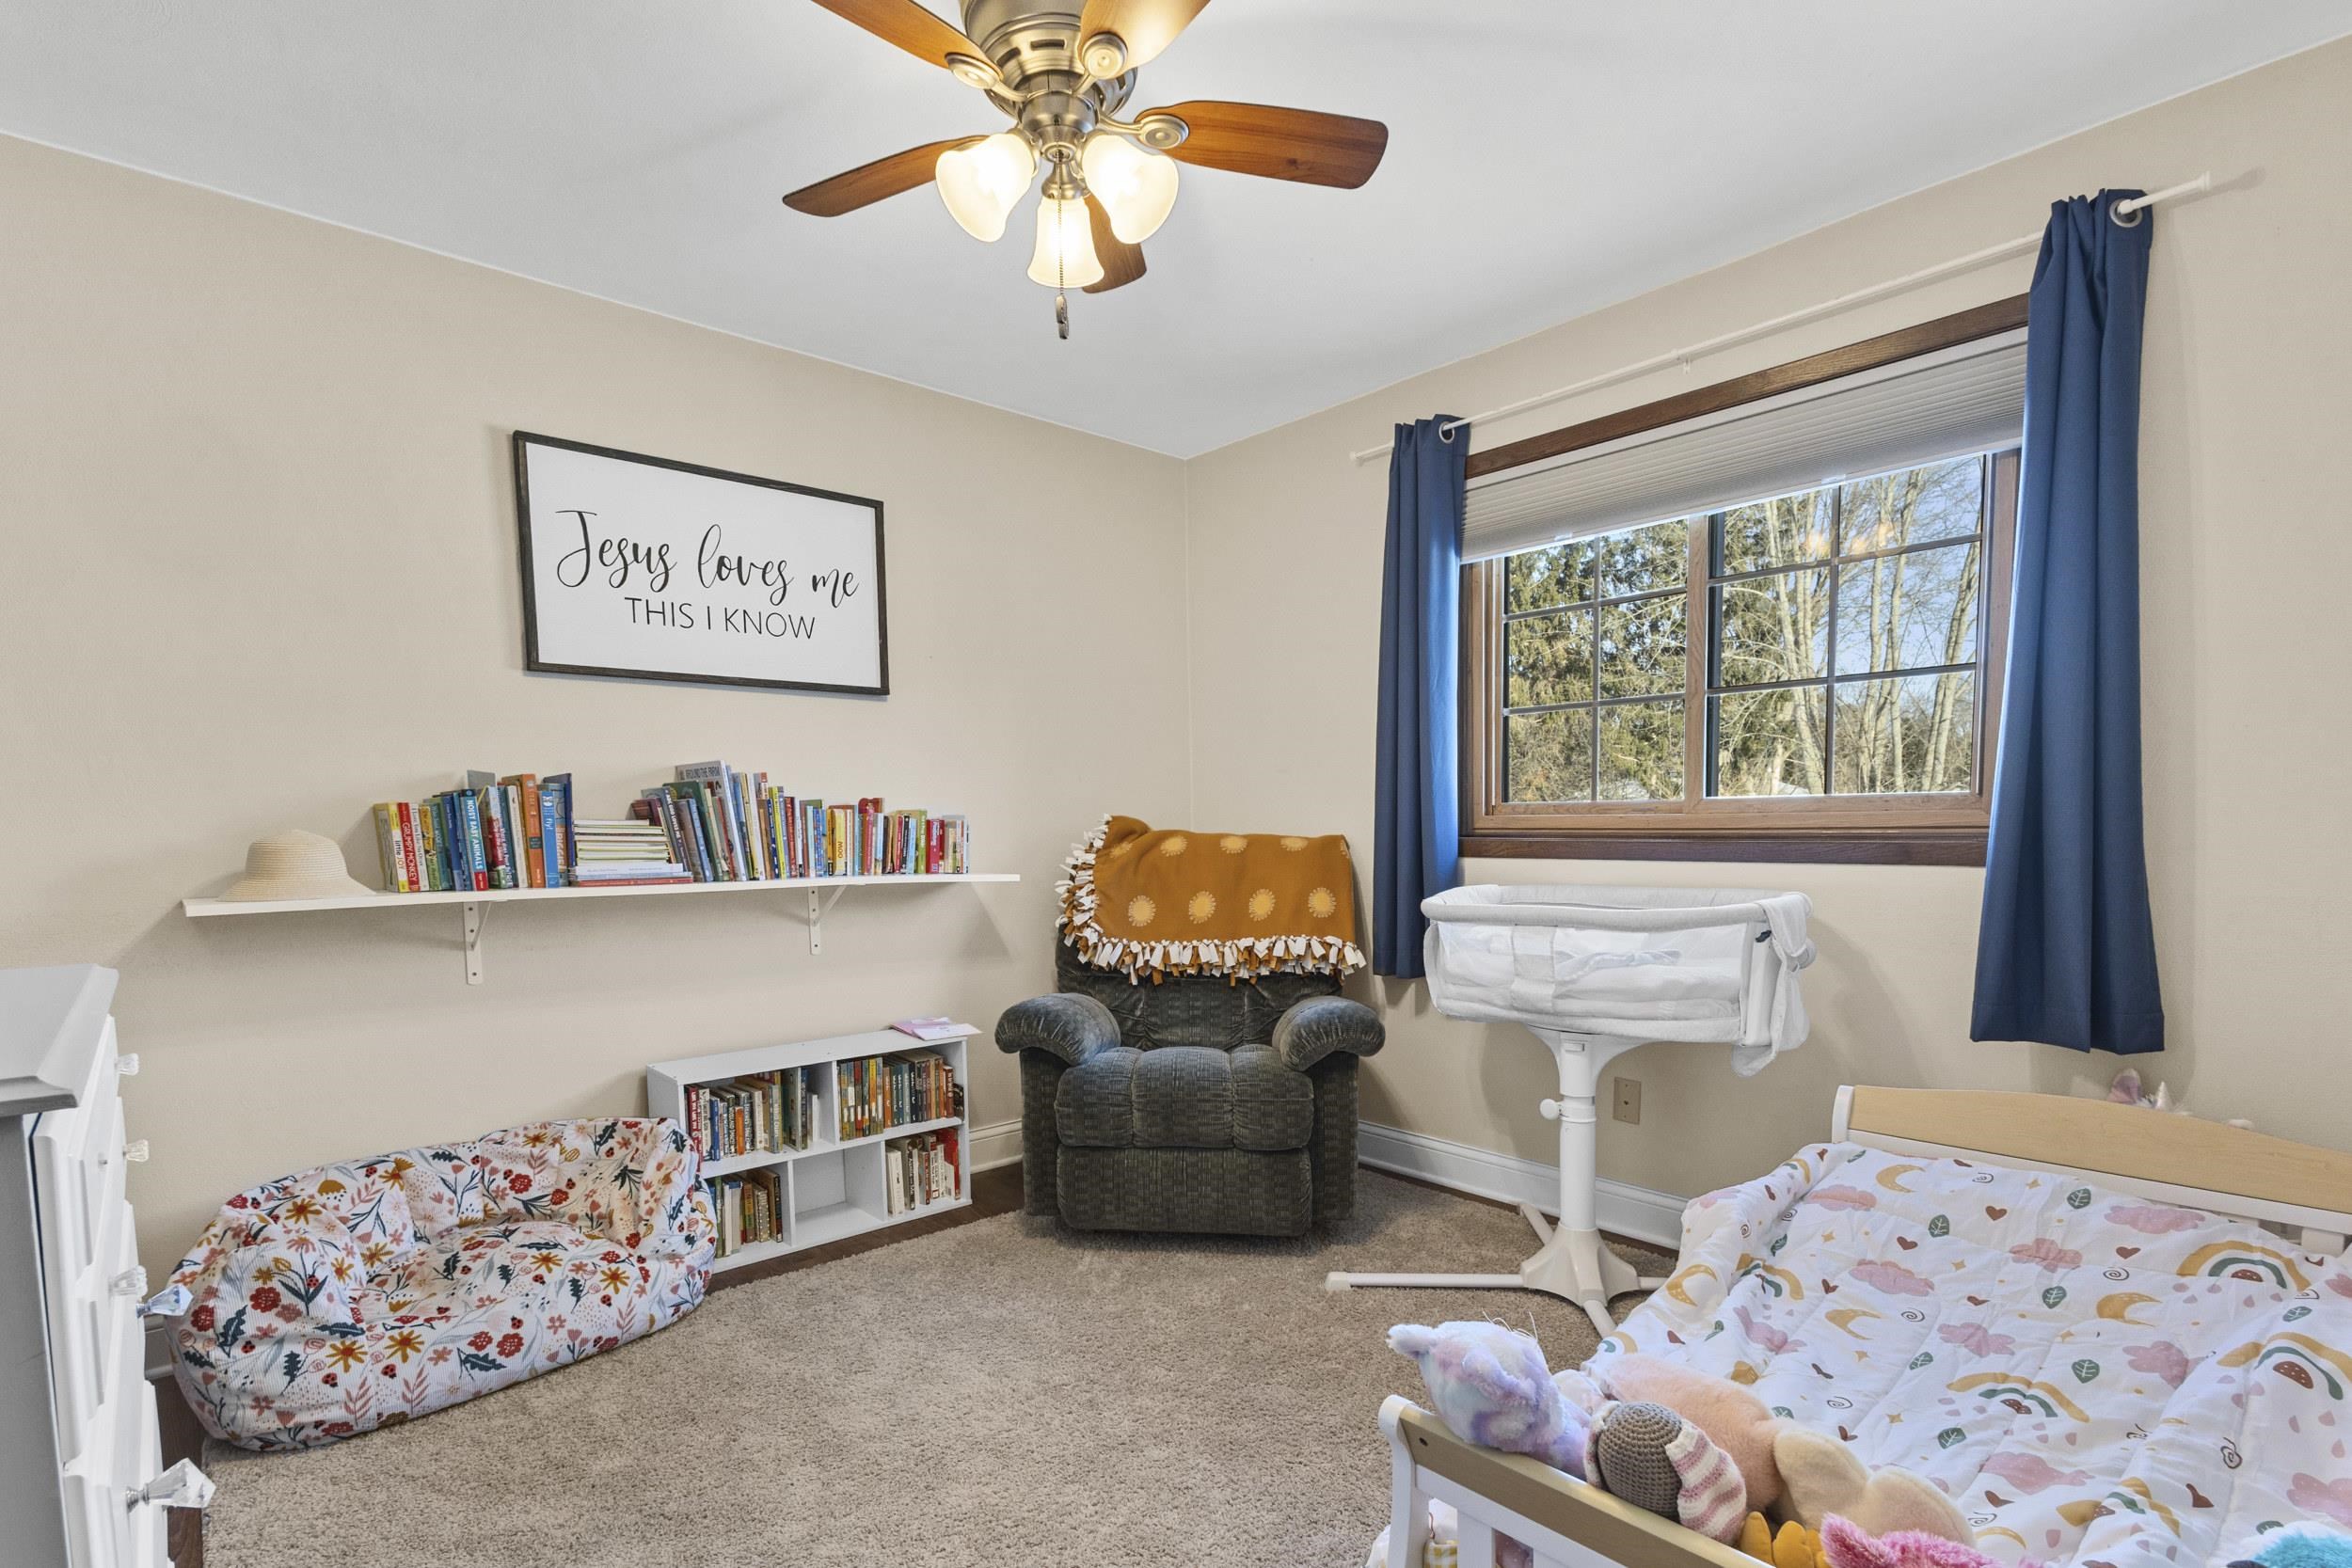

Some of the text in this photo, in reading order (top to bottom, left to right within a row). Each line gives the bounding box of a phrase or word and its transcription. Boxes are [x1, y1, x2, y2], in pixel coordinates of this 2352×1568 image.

[555, 510, 860, 609] Jesus loves me
[624, 596, 816, 640] THIS I KNOW
[402, 822, 417, 880] GRUMPY MONKEY
[467, 800, 484, 869] NOISY BABY ANIMALS
